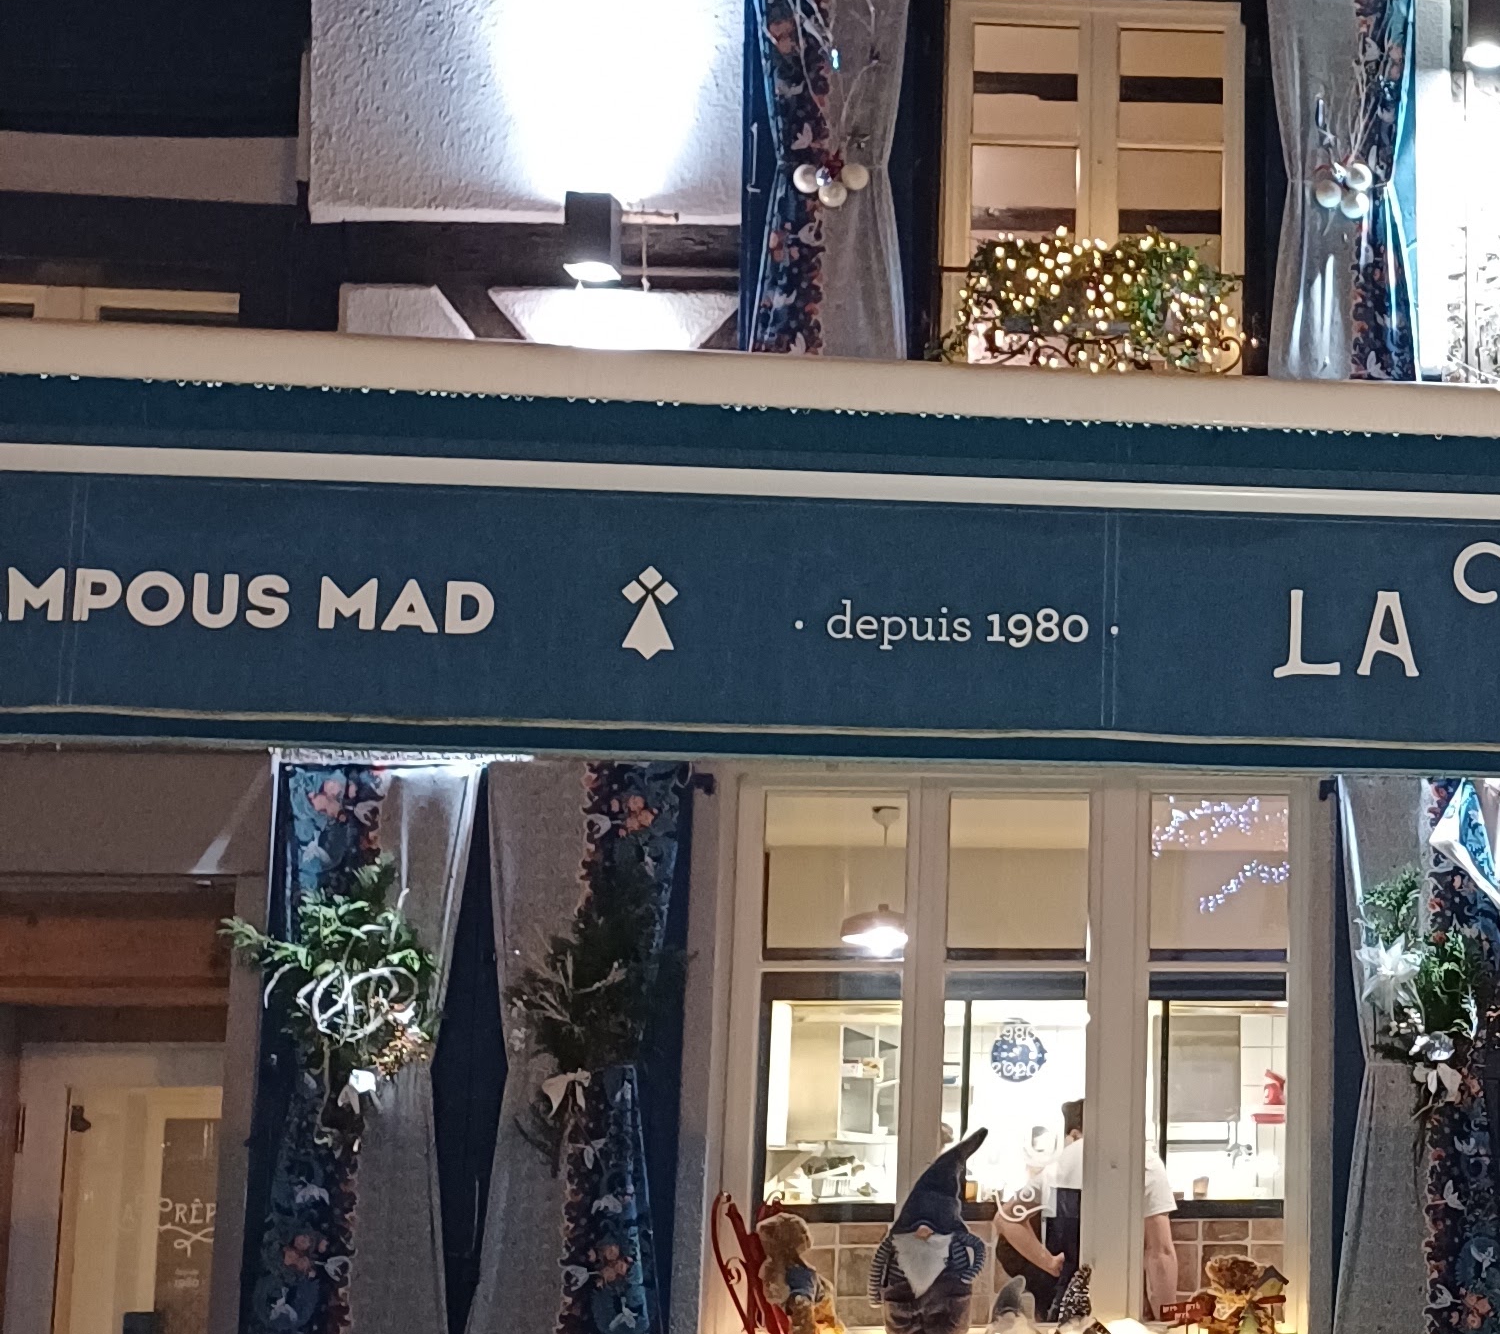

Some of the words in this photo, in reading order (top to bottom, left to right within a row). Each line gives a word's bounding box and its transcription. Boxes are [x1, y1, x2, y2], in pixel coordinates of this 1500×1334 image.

[0, 567, 290, 629] MPOUS
[318, 576, 495, 634] MAD
[827, 599, 972, 650] depuis
[986, 608, 1090, 648] 1980
[1273, 589, 1420, 678] LA
